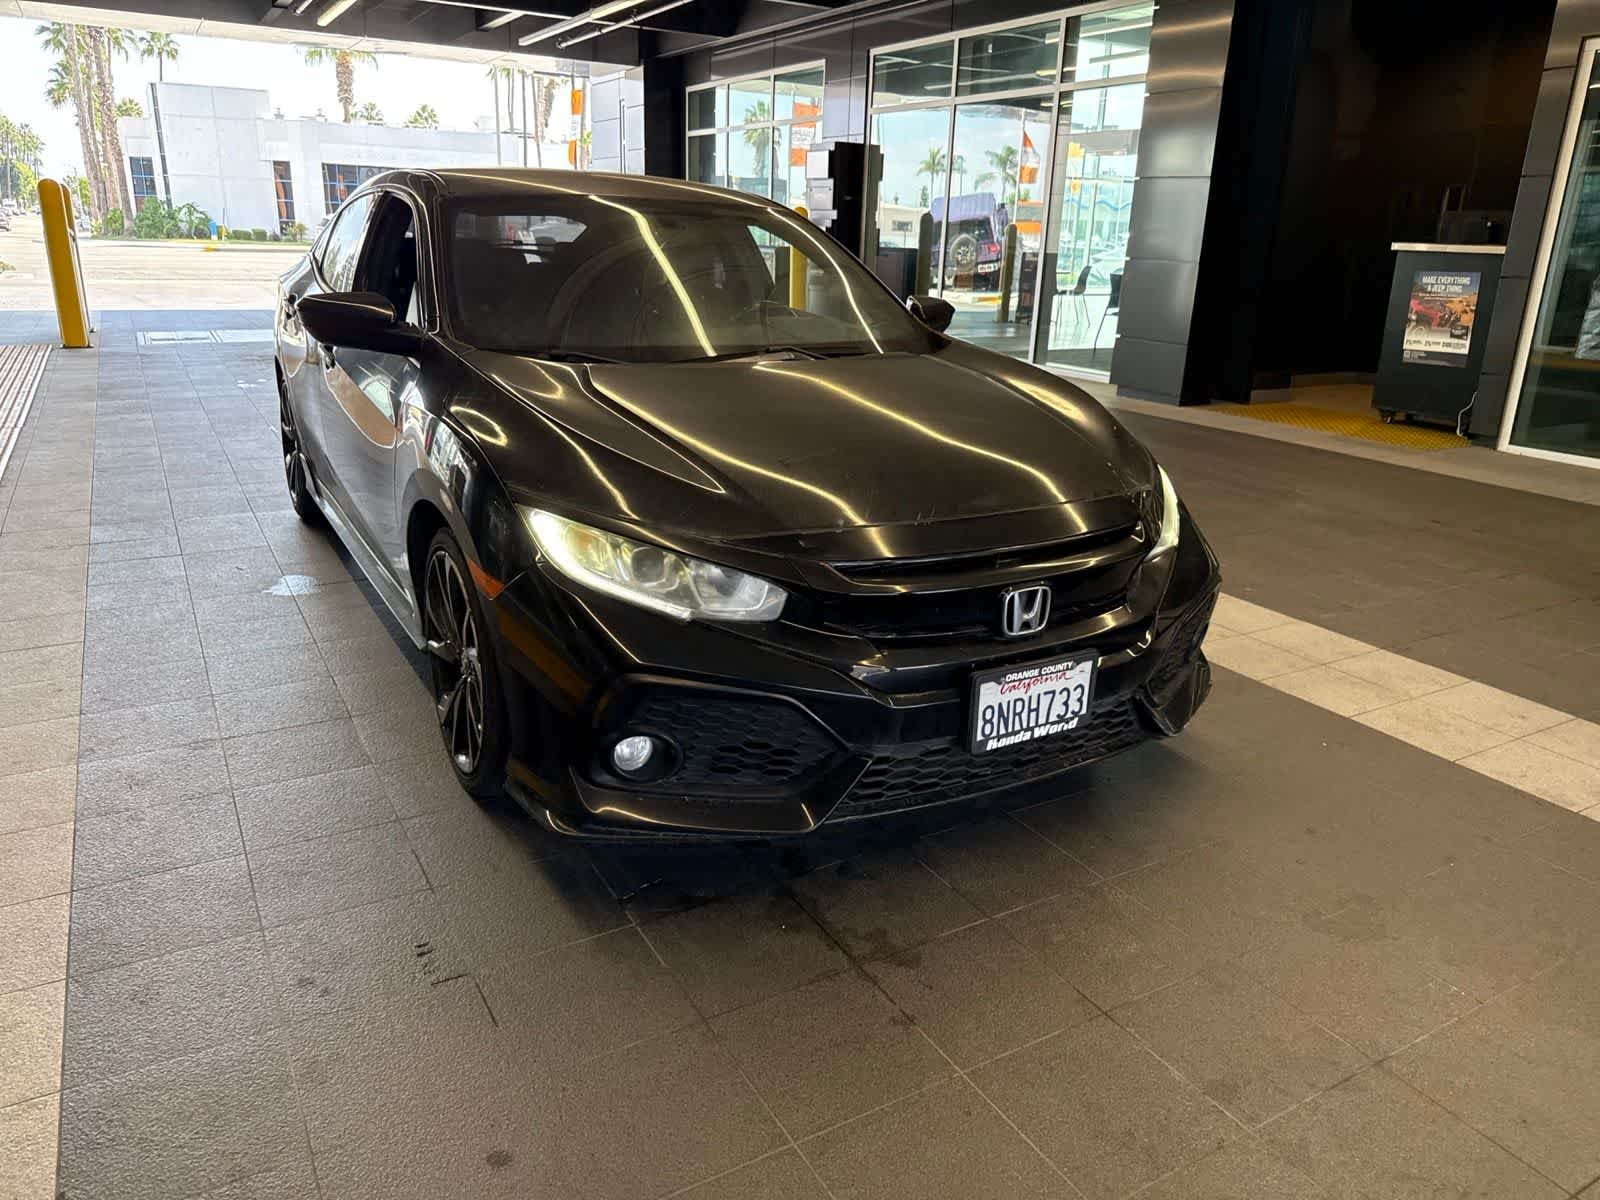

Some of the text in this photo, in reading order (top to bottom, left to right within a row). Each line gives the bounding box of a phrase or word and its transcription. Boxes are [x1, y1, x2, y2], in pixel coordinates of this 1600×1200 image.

[999, 671, 1072, 695] California
[1005, 660, 1074, 682] ORANGE COUNTY
[981, 683, 1085, 737] 8NRH733
[985, 717, 1079, 751] Honda World
